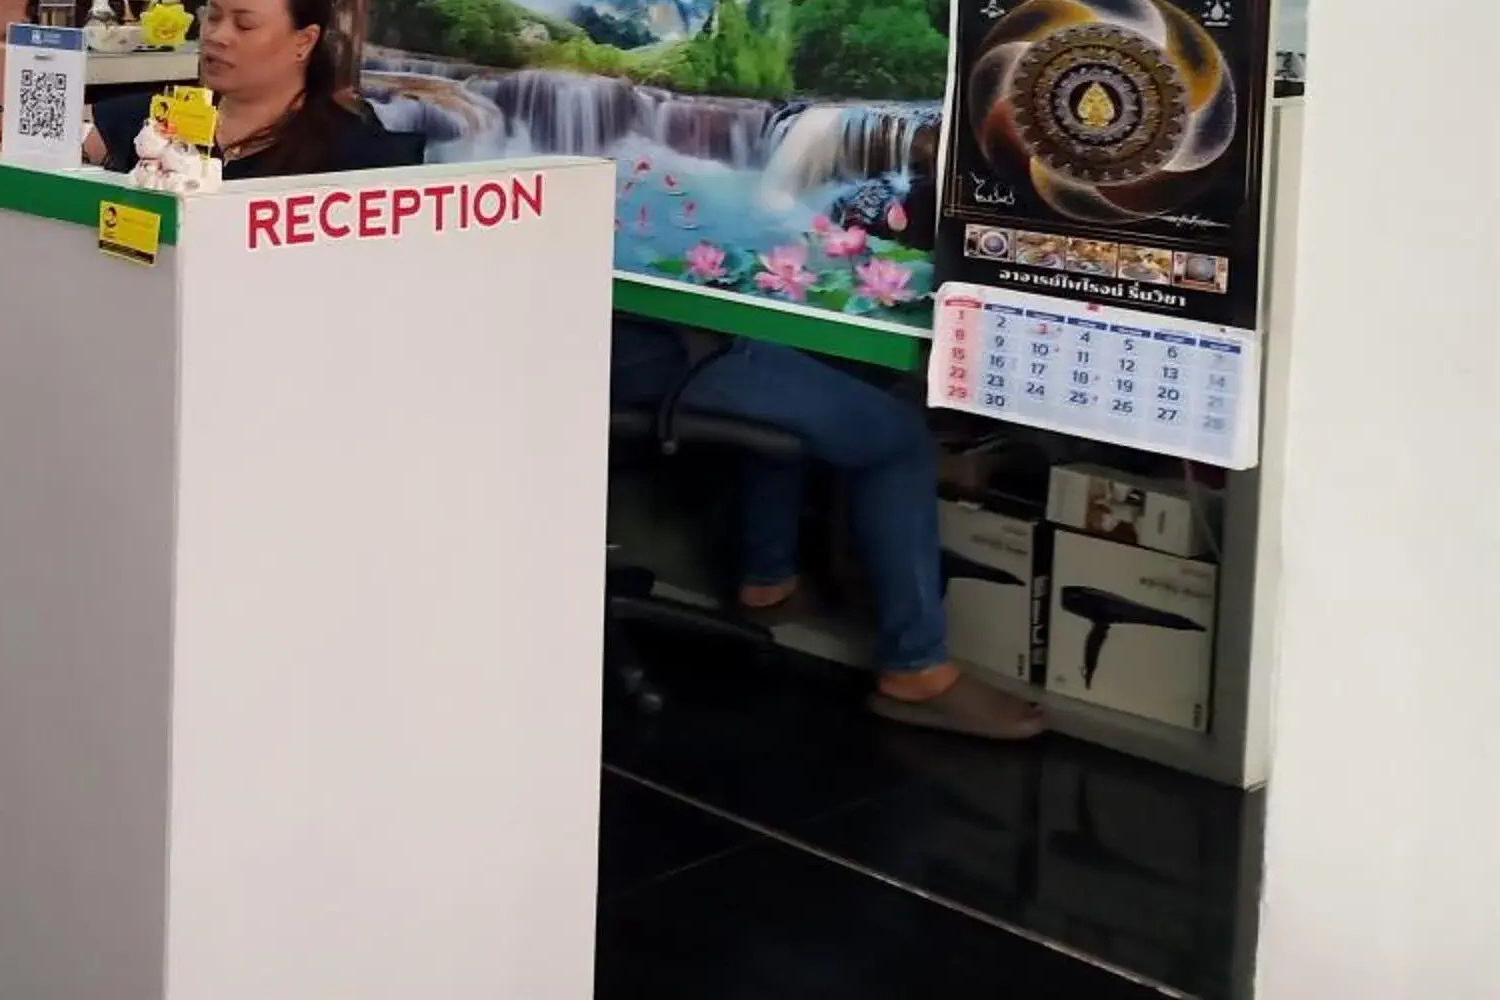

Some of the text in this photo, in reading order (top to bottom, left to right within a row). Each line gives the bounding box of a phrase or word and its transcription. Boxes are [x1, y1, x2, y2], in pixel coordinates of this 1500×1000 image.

[247, 174, 543, 249] RECEPTION
[995, 335, 1005, 348] 9
[1031, 343, 1049, 357] 10
[1077, 351, 1089, 364] 11
[1119, 359, 1135, 373] 12
[1162, 366, 1179, 380] 13
[997, 316, 1006, 328] 2
[1080, 330, 1090, 343] 4
[1123, 339, 1134, 351] 5
[1167, 346, 1177, 359] 6
[948, 385, 1005, 407] 29 30
[950, 366, 966, 380] 22
[987, 374, 1005, 388] 23
[1026, 381, 1045, 396] 24
[1069, 390, 1089, 405] 25
[1112, 399, 1133, 413] 26
[1157, 407, 1178, 421] 27
[952, 347, 965, 361] 15
[990, 355, 1005, 369] 16
[1031, 362, 1046, 376] 17
[1072, 370, 1089, 385] 18
[1116, 378, 1133, 393] 19
[1157, 386, 1180, 401] 20
